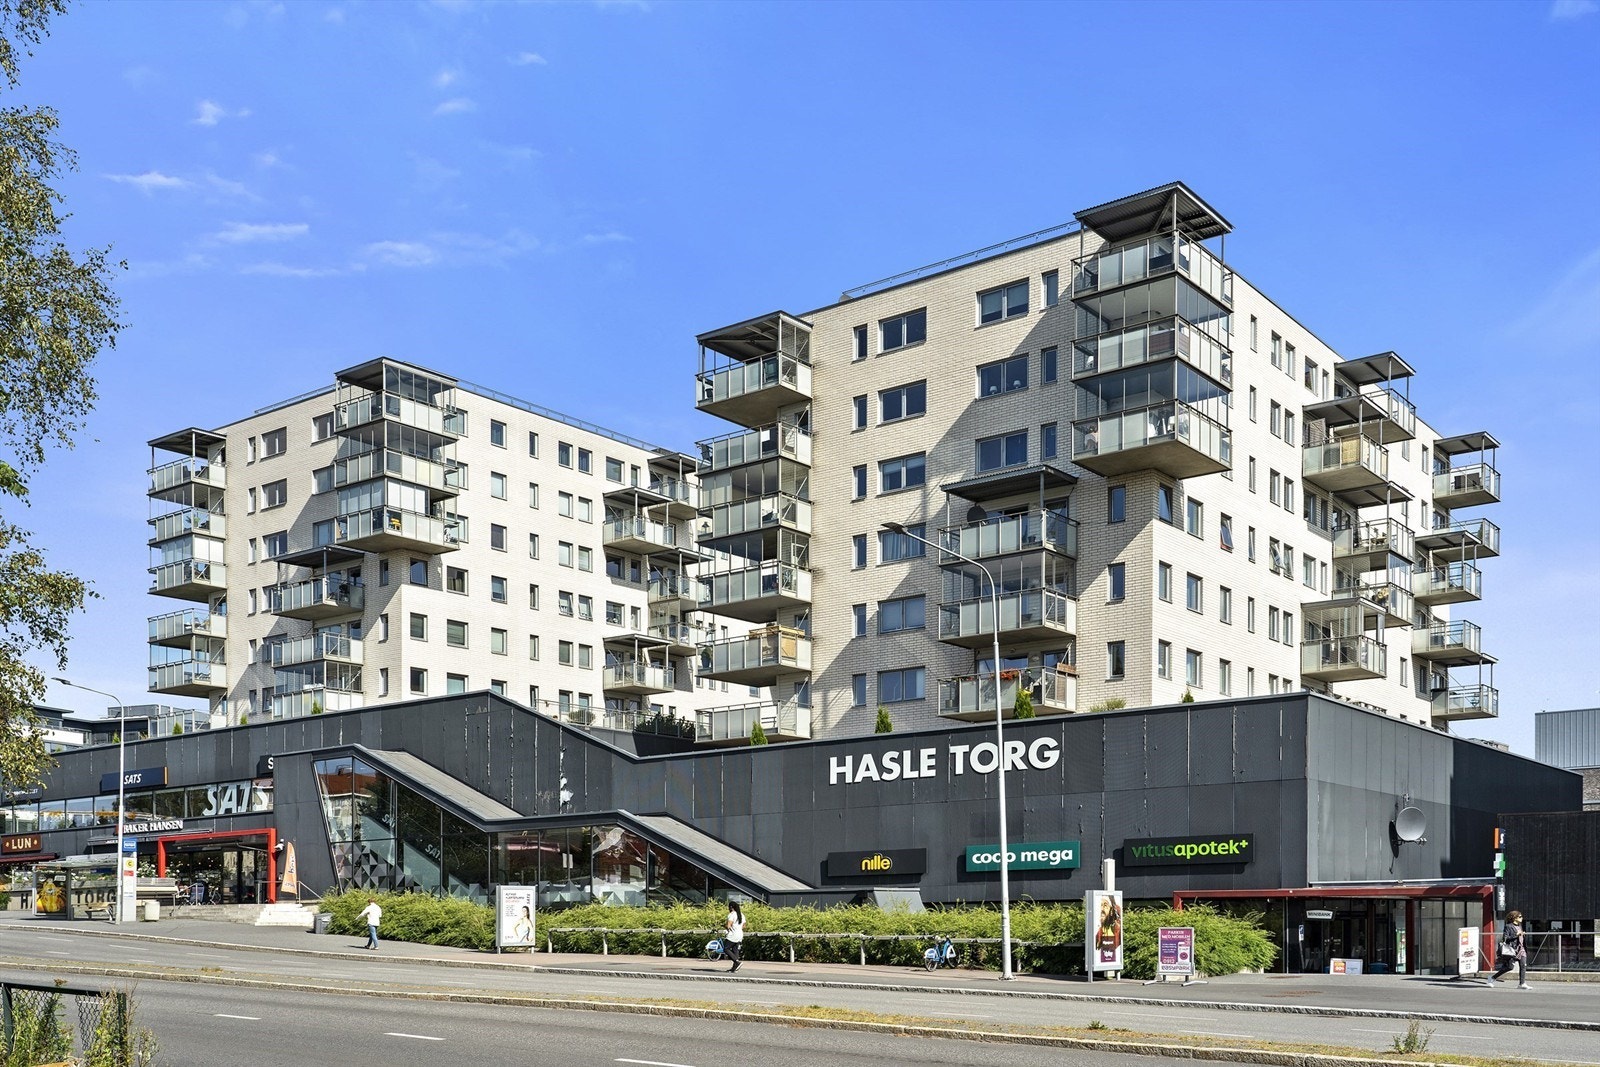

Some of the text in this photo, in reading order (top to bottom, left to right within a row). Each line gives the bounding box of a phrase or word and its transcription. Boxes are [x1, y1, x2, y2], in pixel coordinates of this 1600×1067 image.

[829, 737, 1060, 785] HASLE TORG
[124, 773, 141, 785] SATS
[202, 781, 269, 816] SATS
[149, 819, 183, 832] HANSEN
[11, 837, 32, 849] LUN
[861, 854, 892, 871] nille
[1020, 848, 1073, 865] mega
